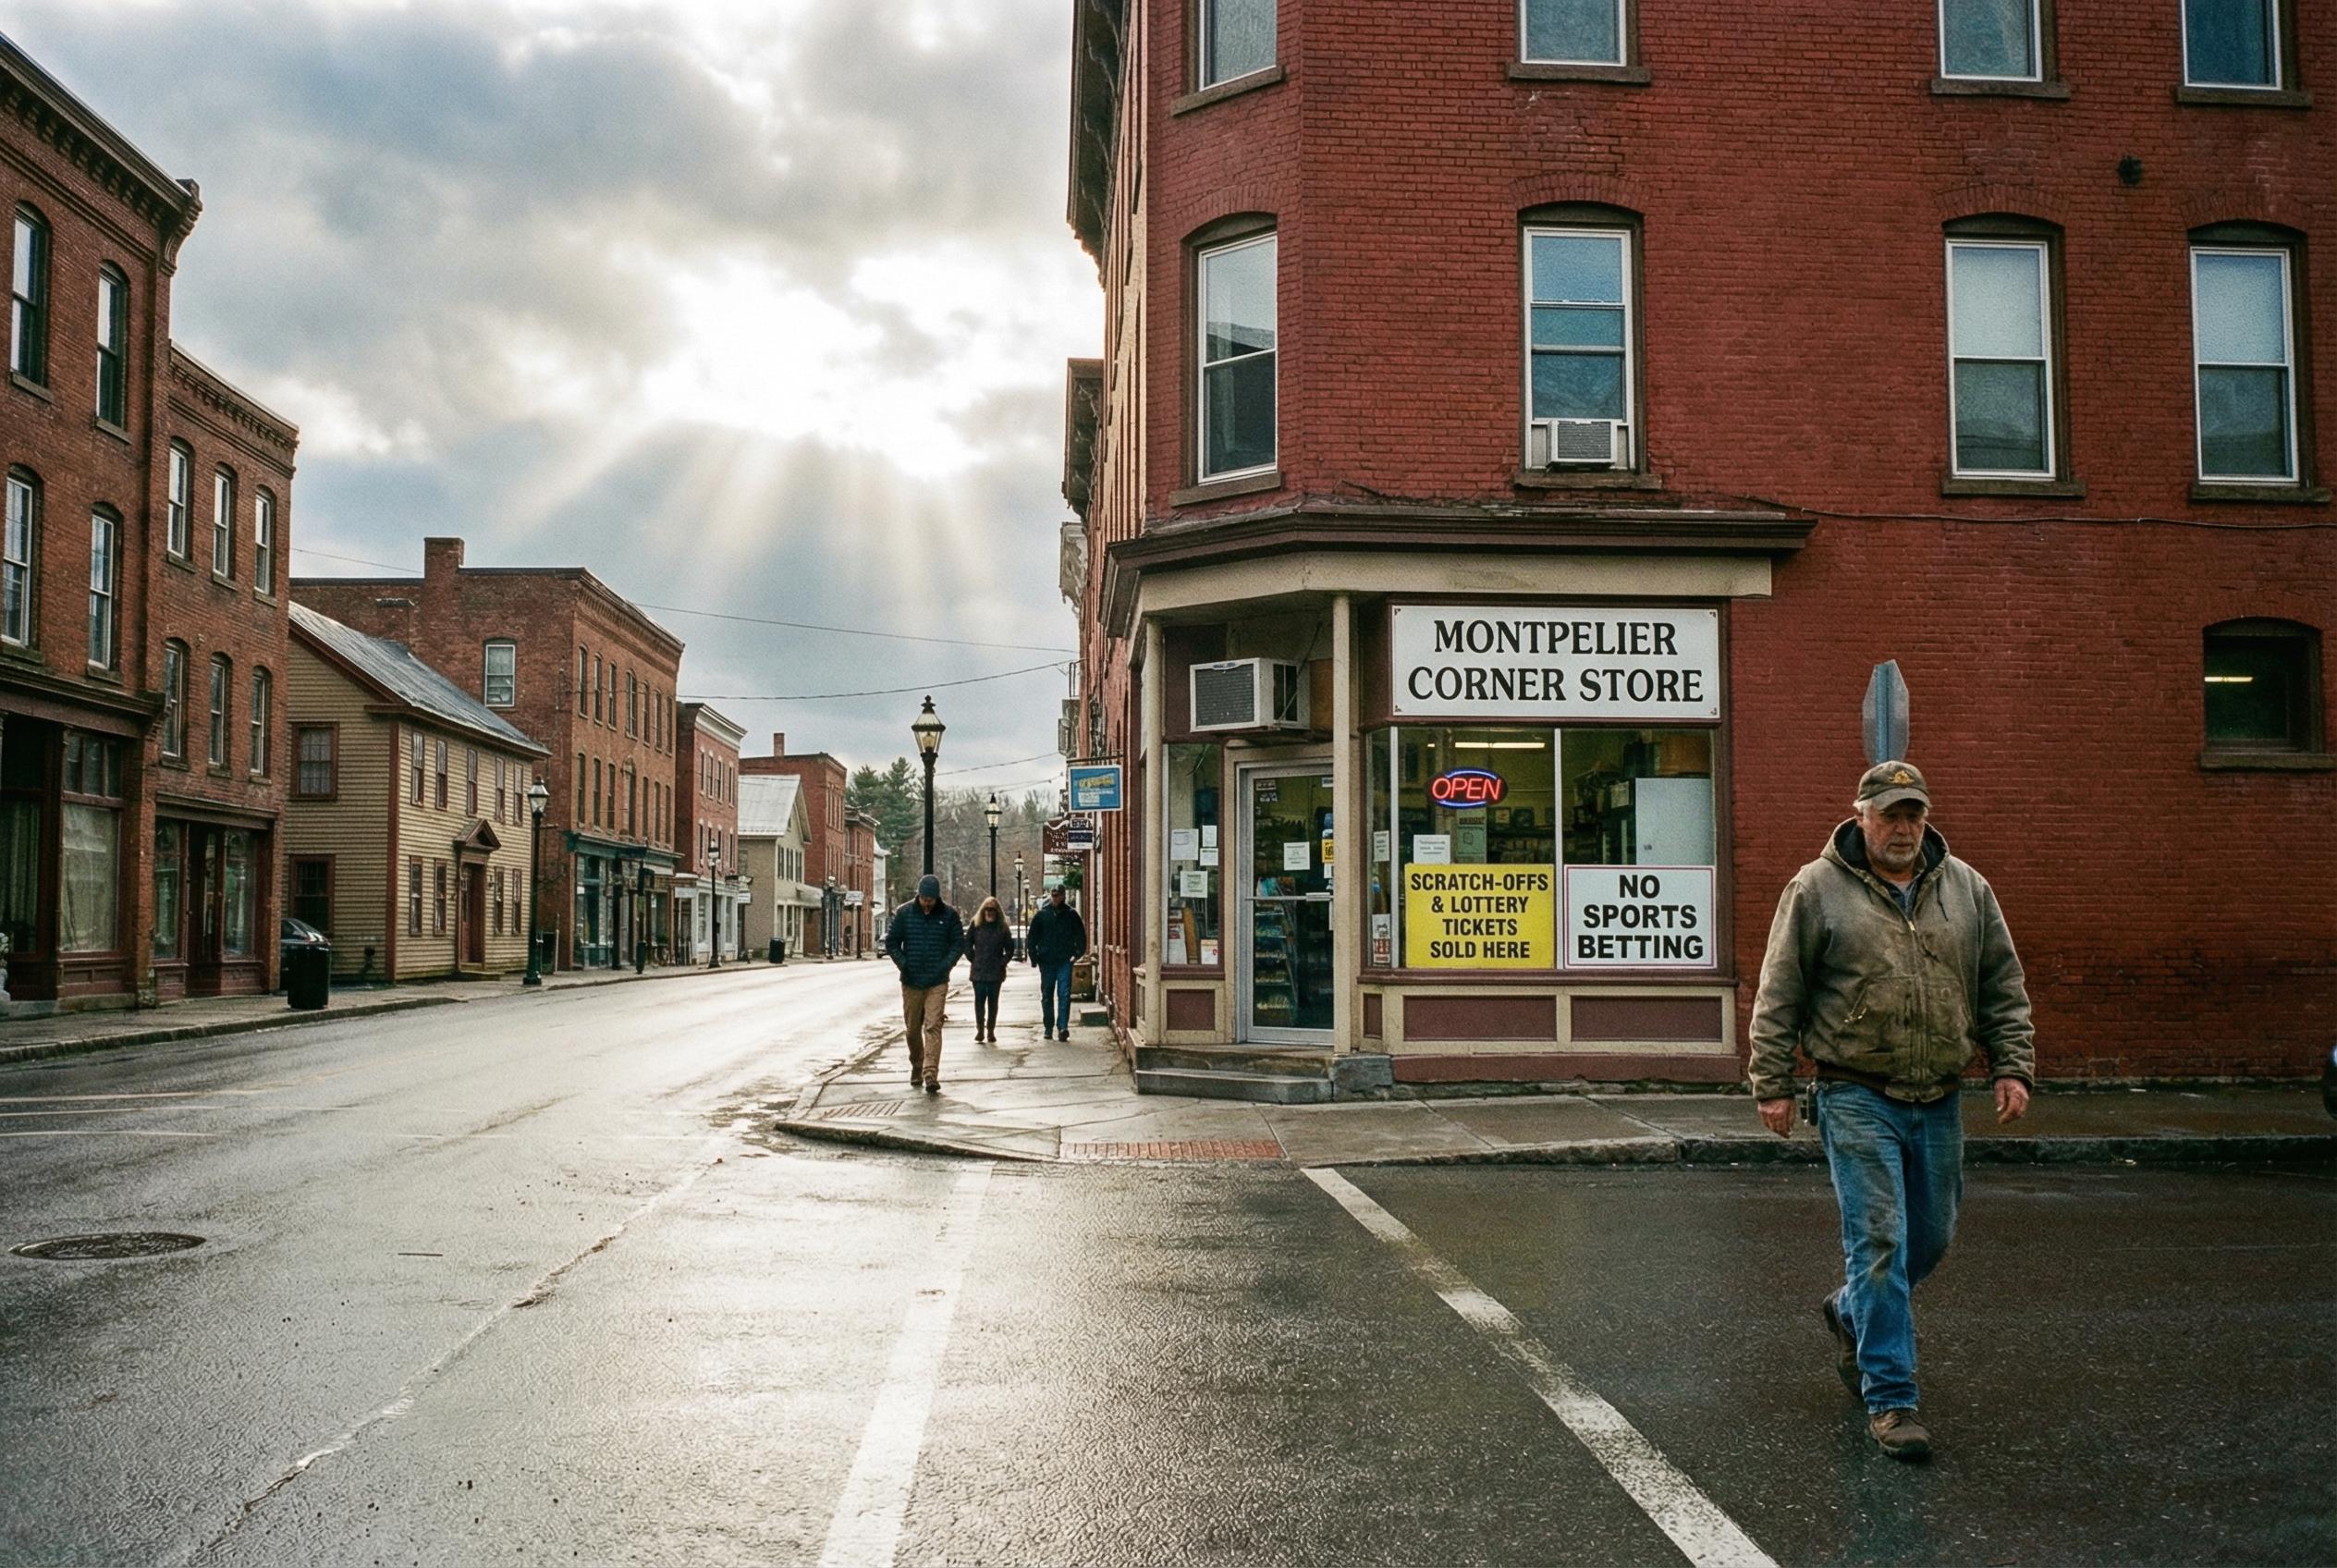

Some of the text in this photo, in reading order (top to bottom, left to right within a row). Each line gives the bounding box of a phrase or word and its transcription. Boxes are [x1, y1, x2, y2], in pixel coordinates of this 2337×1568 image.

[1434, 619, 1678, 655] MONTPELIER
[1408, 666, 1704, 703] CORNER STORE
[1431, 778, 1501, 801] OPEN
[1410, 873, 1548, 891] SCRATCH-OFFS
[1619, 874, 1660, 900] NO
[1431, 895, 1529, 913] & LOTTERY
[1583, 903, 1697, 929] SPORTS
[1442, 918, 1518, 937] TICKETS
[1430, 940, 1531, 959] SOLD HERE
[1577, 935, 1704, 960] BETTING
